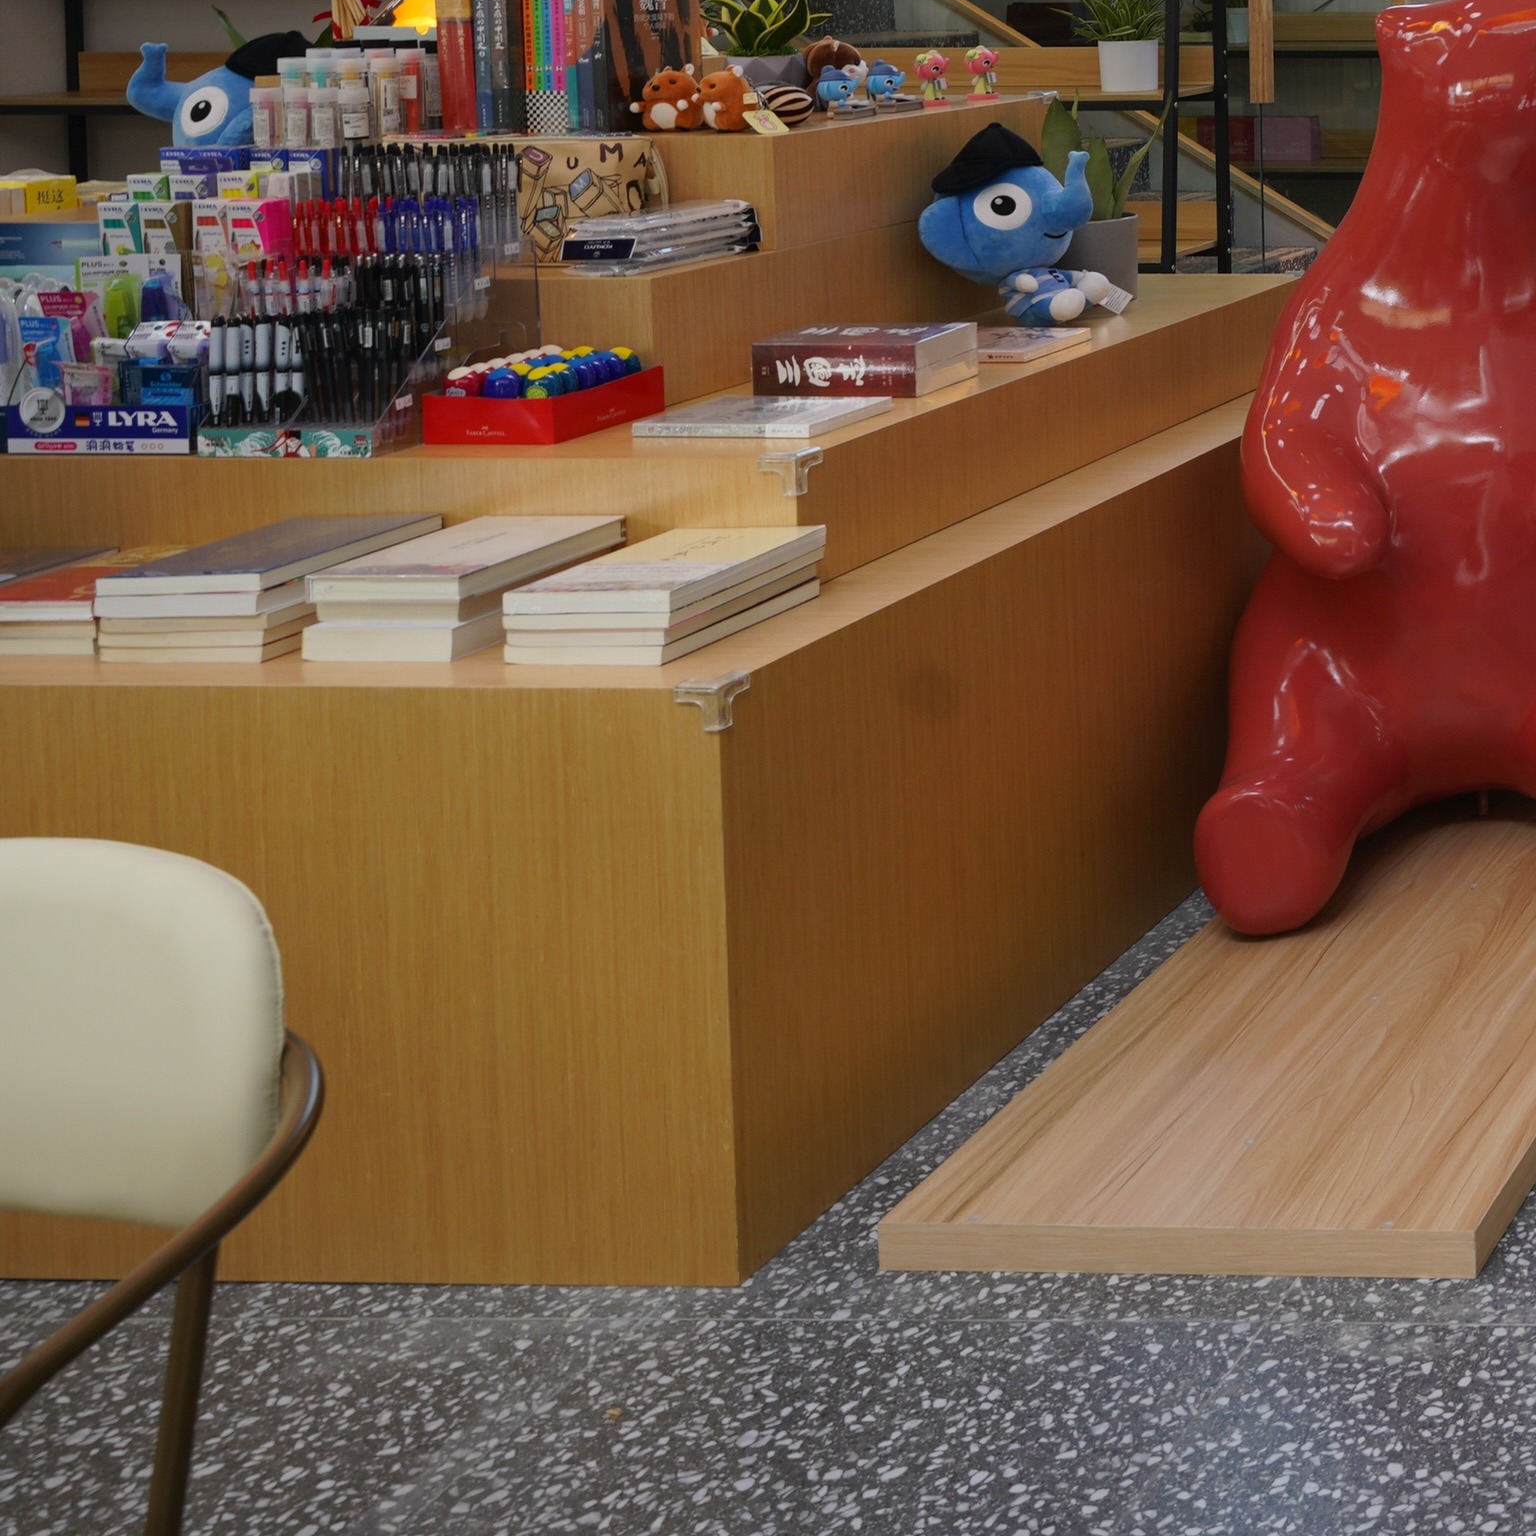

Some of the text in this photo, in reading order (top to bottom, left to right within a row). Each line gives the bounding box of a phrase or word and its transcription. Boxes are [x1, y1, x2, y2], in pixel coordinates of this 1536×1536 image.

[40, 294, 62, 302] PLUS
[20, 319, 40, 328] PLUS
[108, 411, 178, 427] LYRA
[152, 427, 178, 435] Germany
